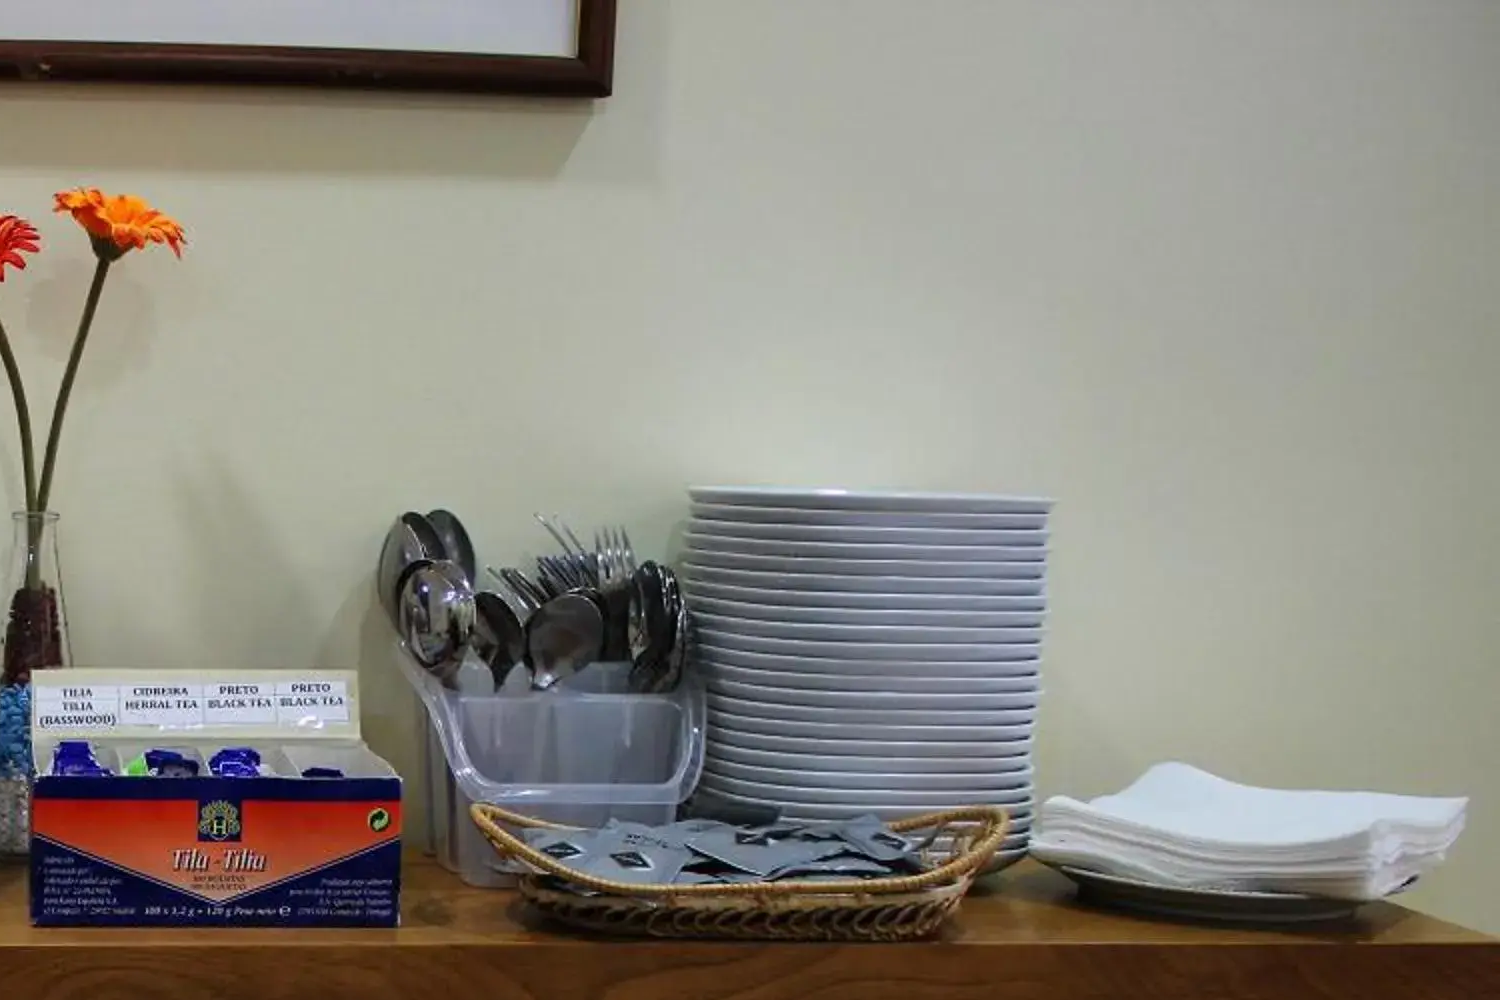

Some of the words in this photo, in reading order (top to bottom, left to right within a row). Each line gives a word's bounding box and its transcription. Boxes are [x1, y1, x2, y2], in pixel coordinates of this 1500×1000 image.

[219, 685, 259, 695] PRETO
[291, 683, 331, 693] PRETO
[176, 699, 198, 709] TEA
[208, 699, 246, 709] BLACK
[250, 698, 271, 708] TEA
[280, 697, 317, 707] BLACK
[323, 697, 343, 705] TEA
[213, 819, 227, 834] H
